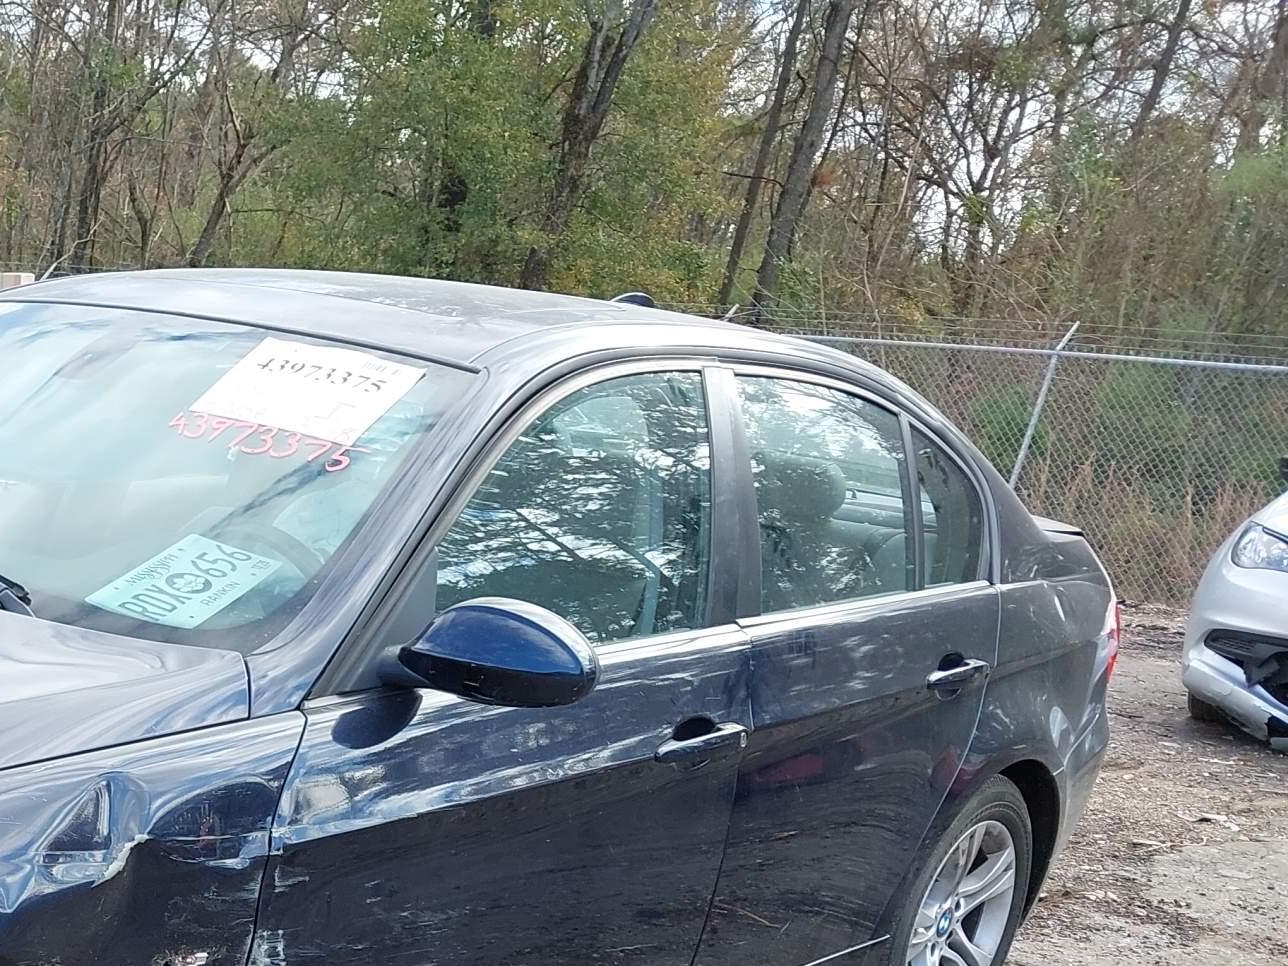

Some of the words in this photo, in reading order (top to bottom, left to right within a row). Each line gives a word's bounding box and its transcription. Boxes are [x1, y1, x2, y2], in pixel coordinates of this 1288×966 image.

[257, 357, 388, 393] 43973375
[168, 412, 373, 472] 43973375
[118, 584, 192, 621] RDX
[191, 544, 252, 578] 656
[201, 580, 240, 606] RANKIN
